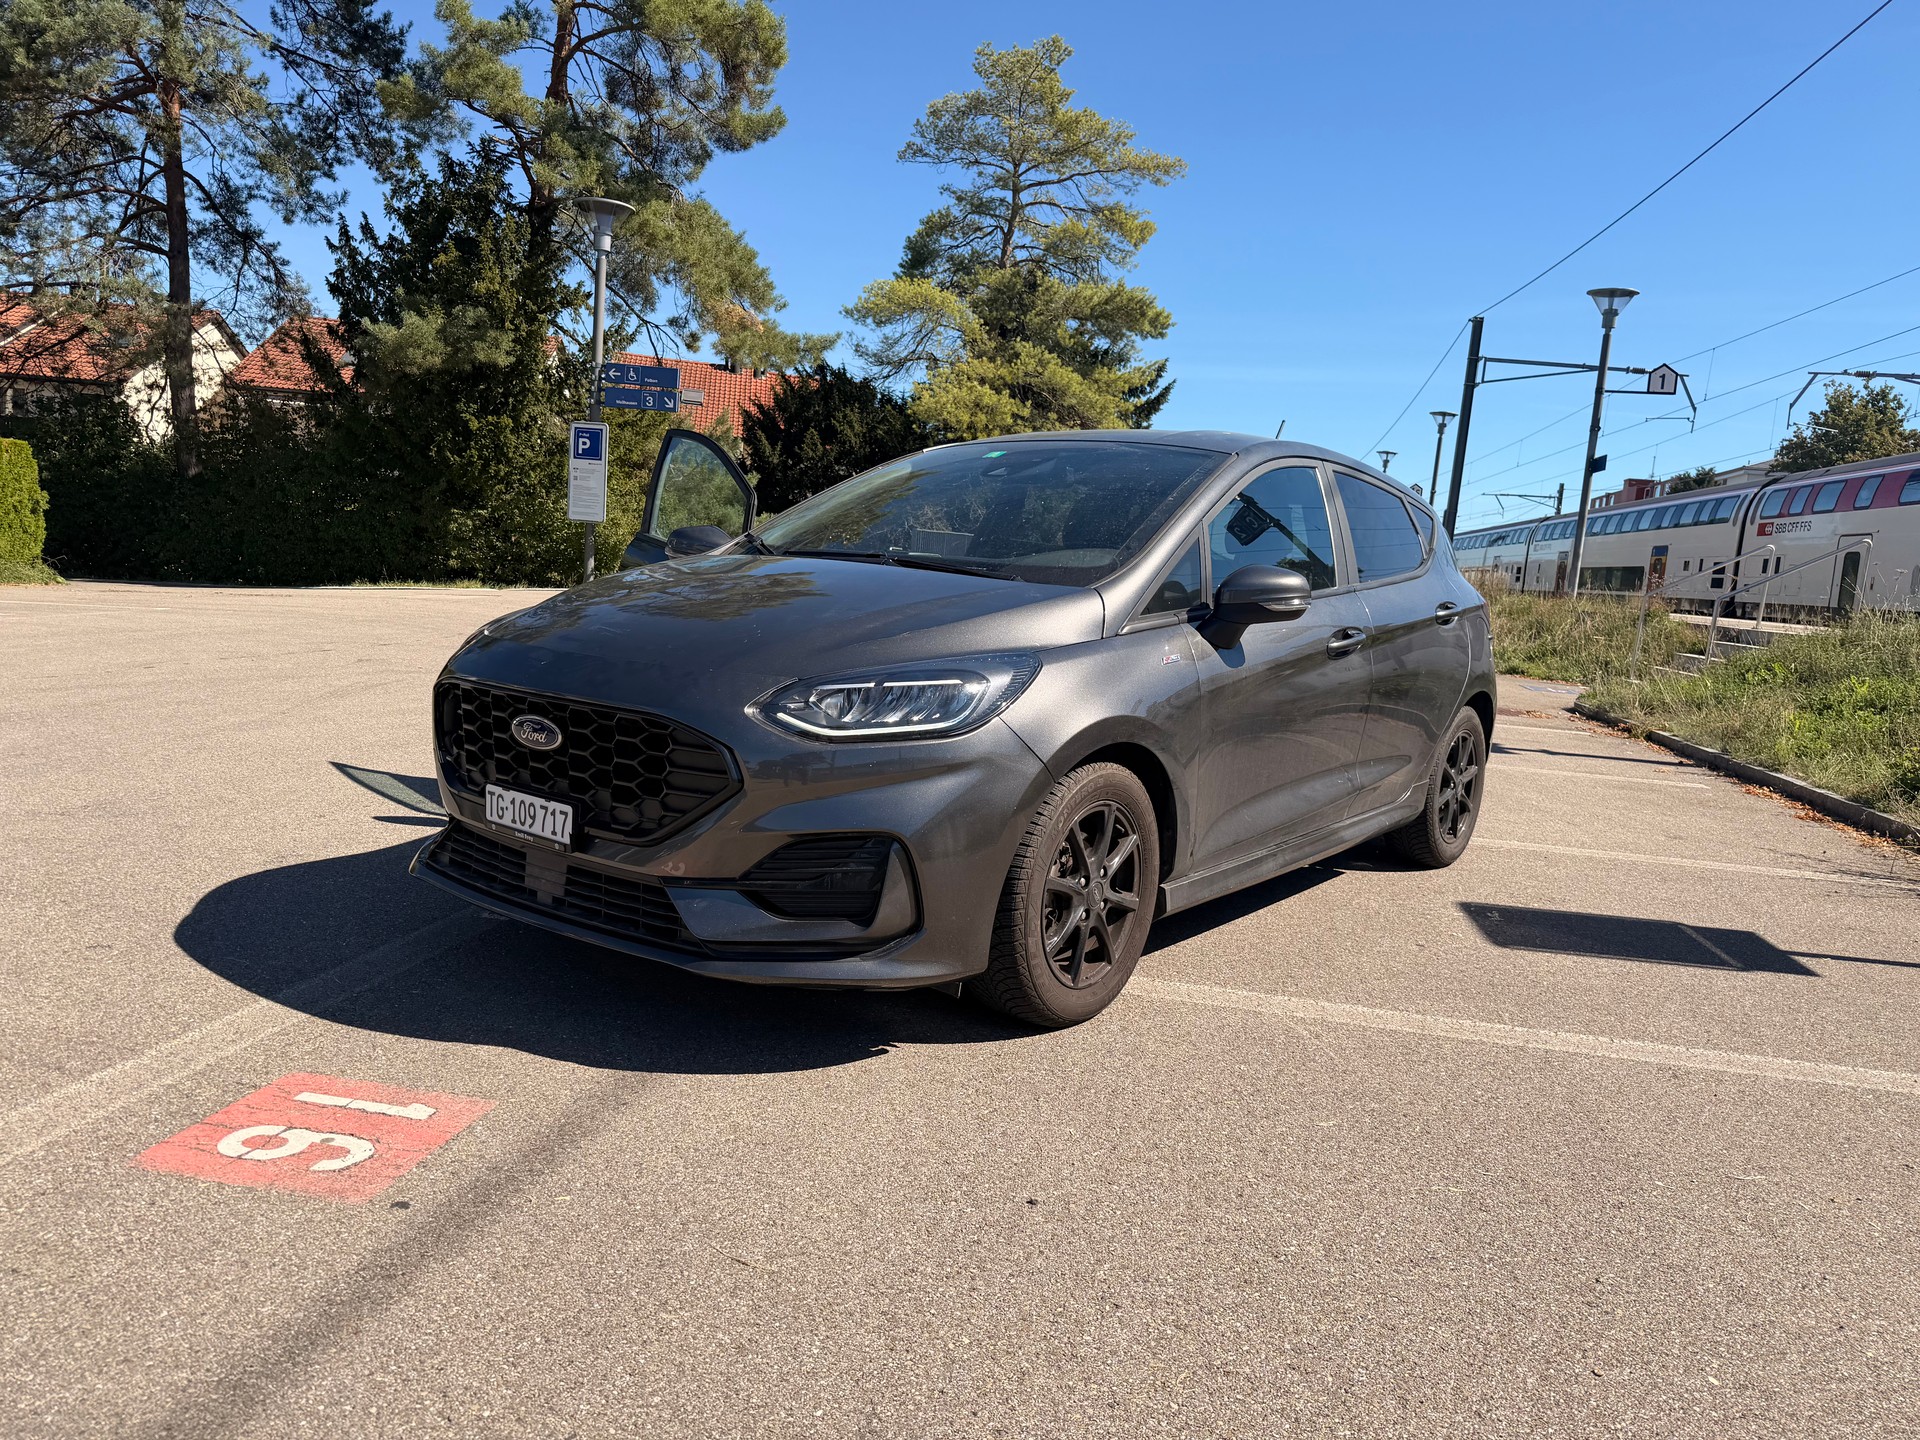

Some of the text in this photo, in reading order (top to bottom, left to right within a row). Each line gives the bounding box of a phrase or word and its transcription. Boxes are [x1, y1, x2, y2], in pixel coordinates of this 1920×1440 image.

[1658, 373, 1666, 390] 1
[646, 396, 654, 407] 3
[578, 437, 591, 454] P
[1774, 521, 1812, 534] SBB CFF FFS
[520, 722, 547, 743] Ford
